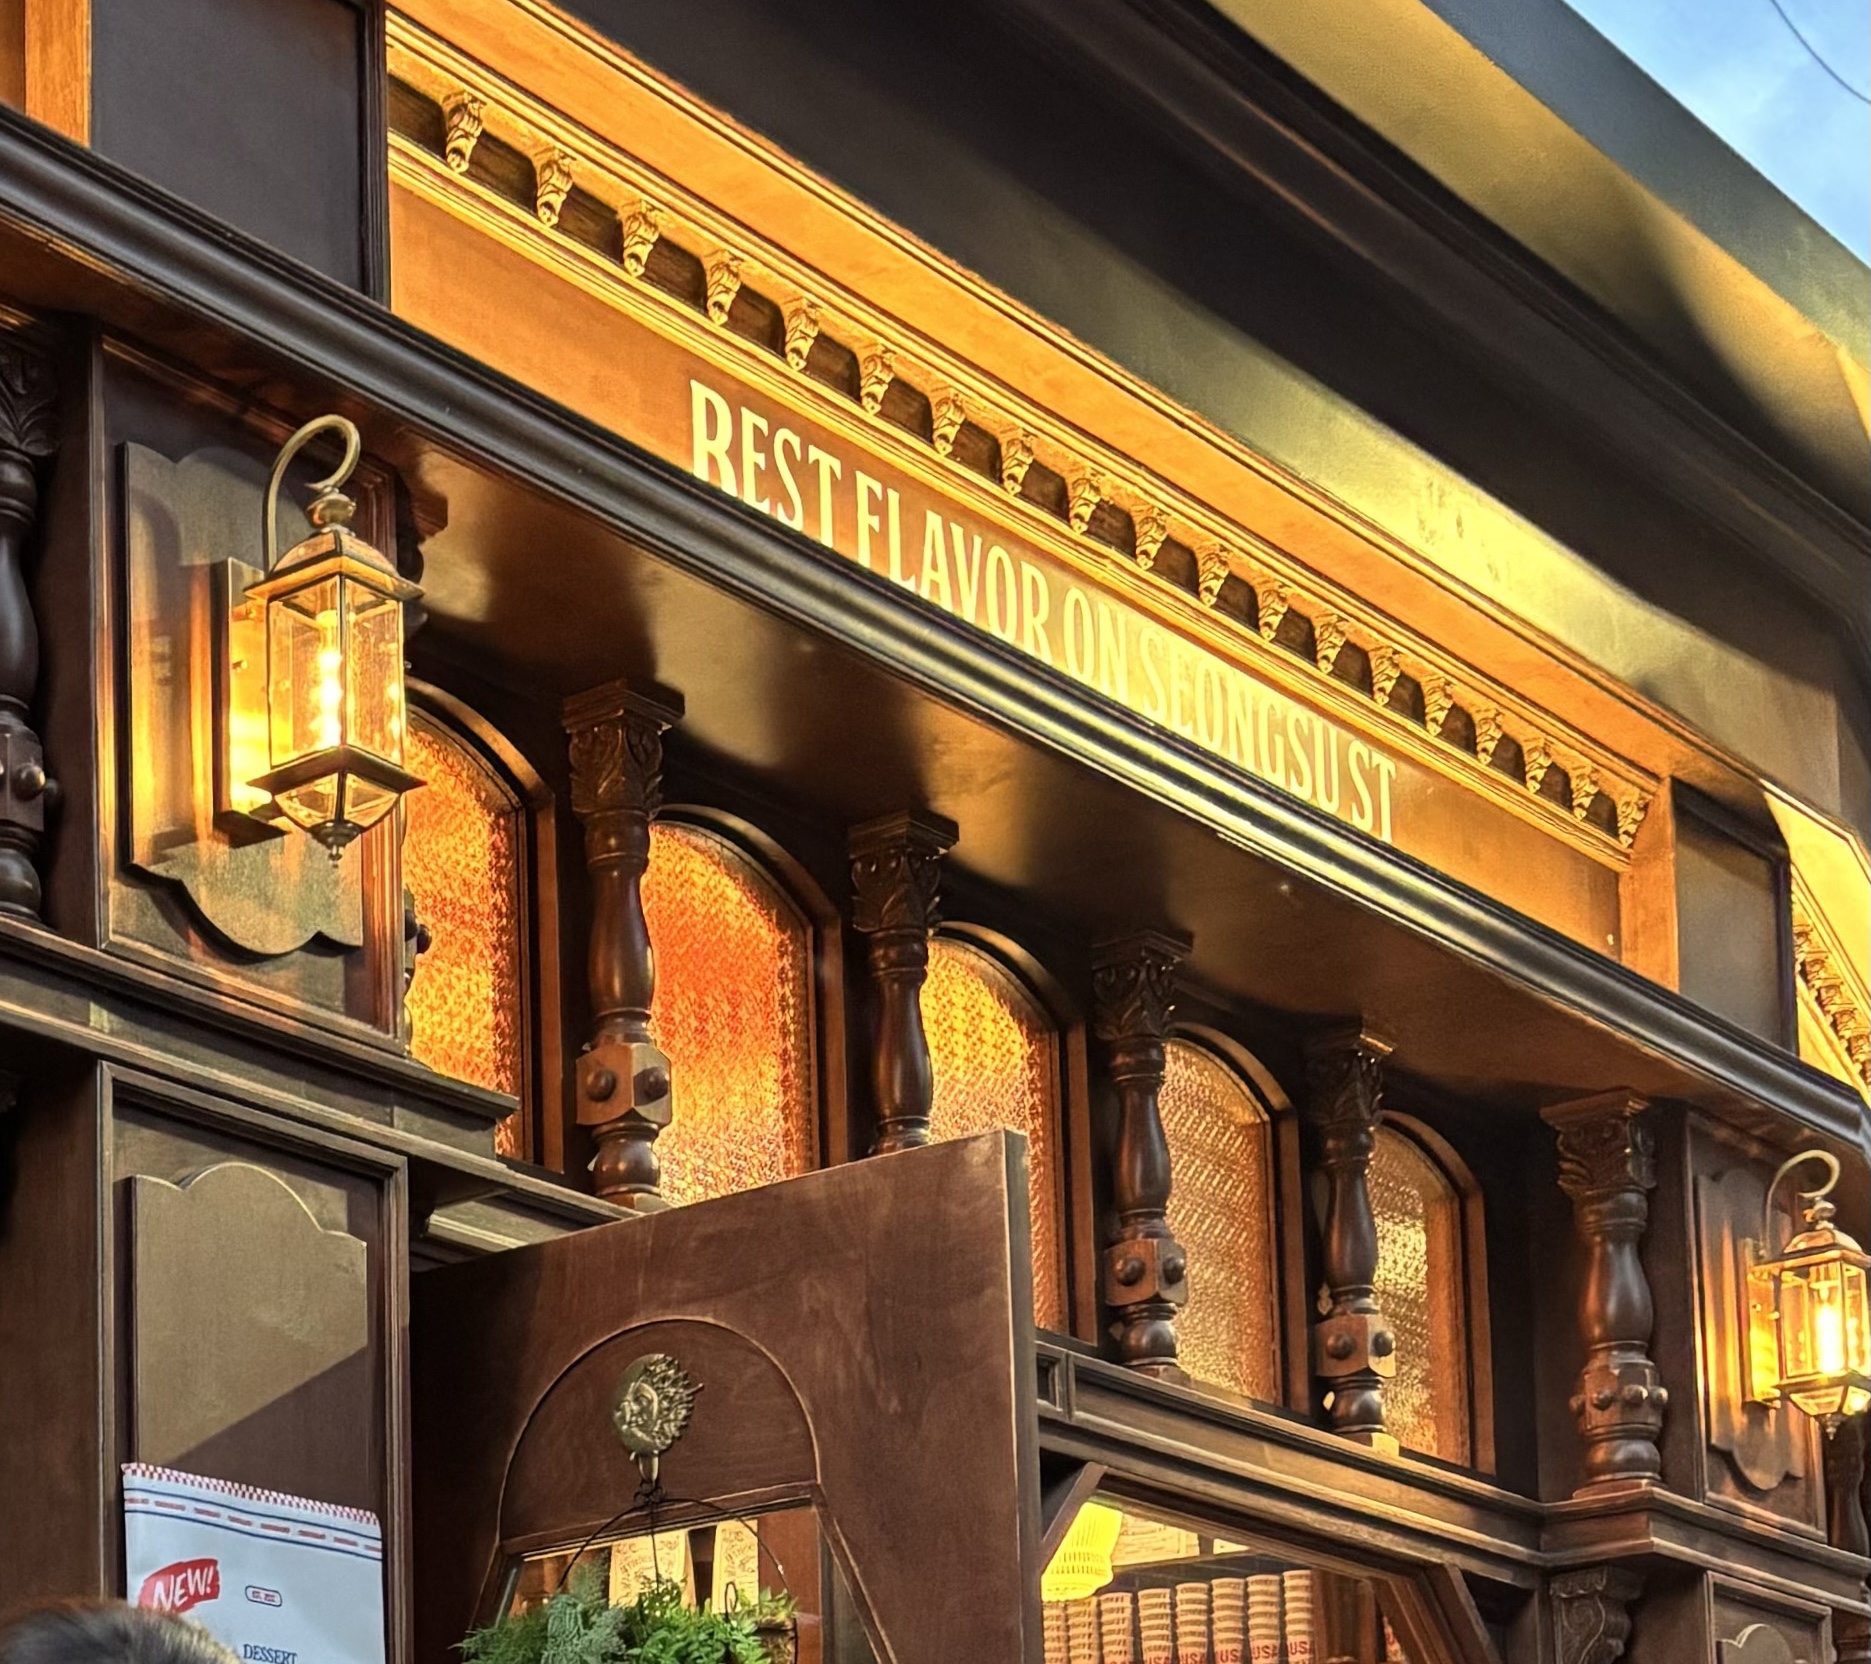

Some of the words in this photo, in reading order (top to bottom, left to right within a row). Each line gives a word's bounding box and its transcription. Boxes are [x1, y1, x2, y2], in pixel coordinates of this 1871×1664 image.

[689, 379, 842, 549] BEST
[855, 470, 1053, 665] FLAVOR
[1063, 586, 1129, 700] ON
[1139, 626, 1340, 815] SEONGSU
[1347, 737, 1397, 845] ST
[152, 1566, 214, 1611] NEW!
